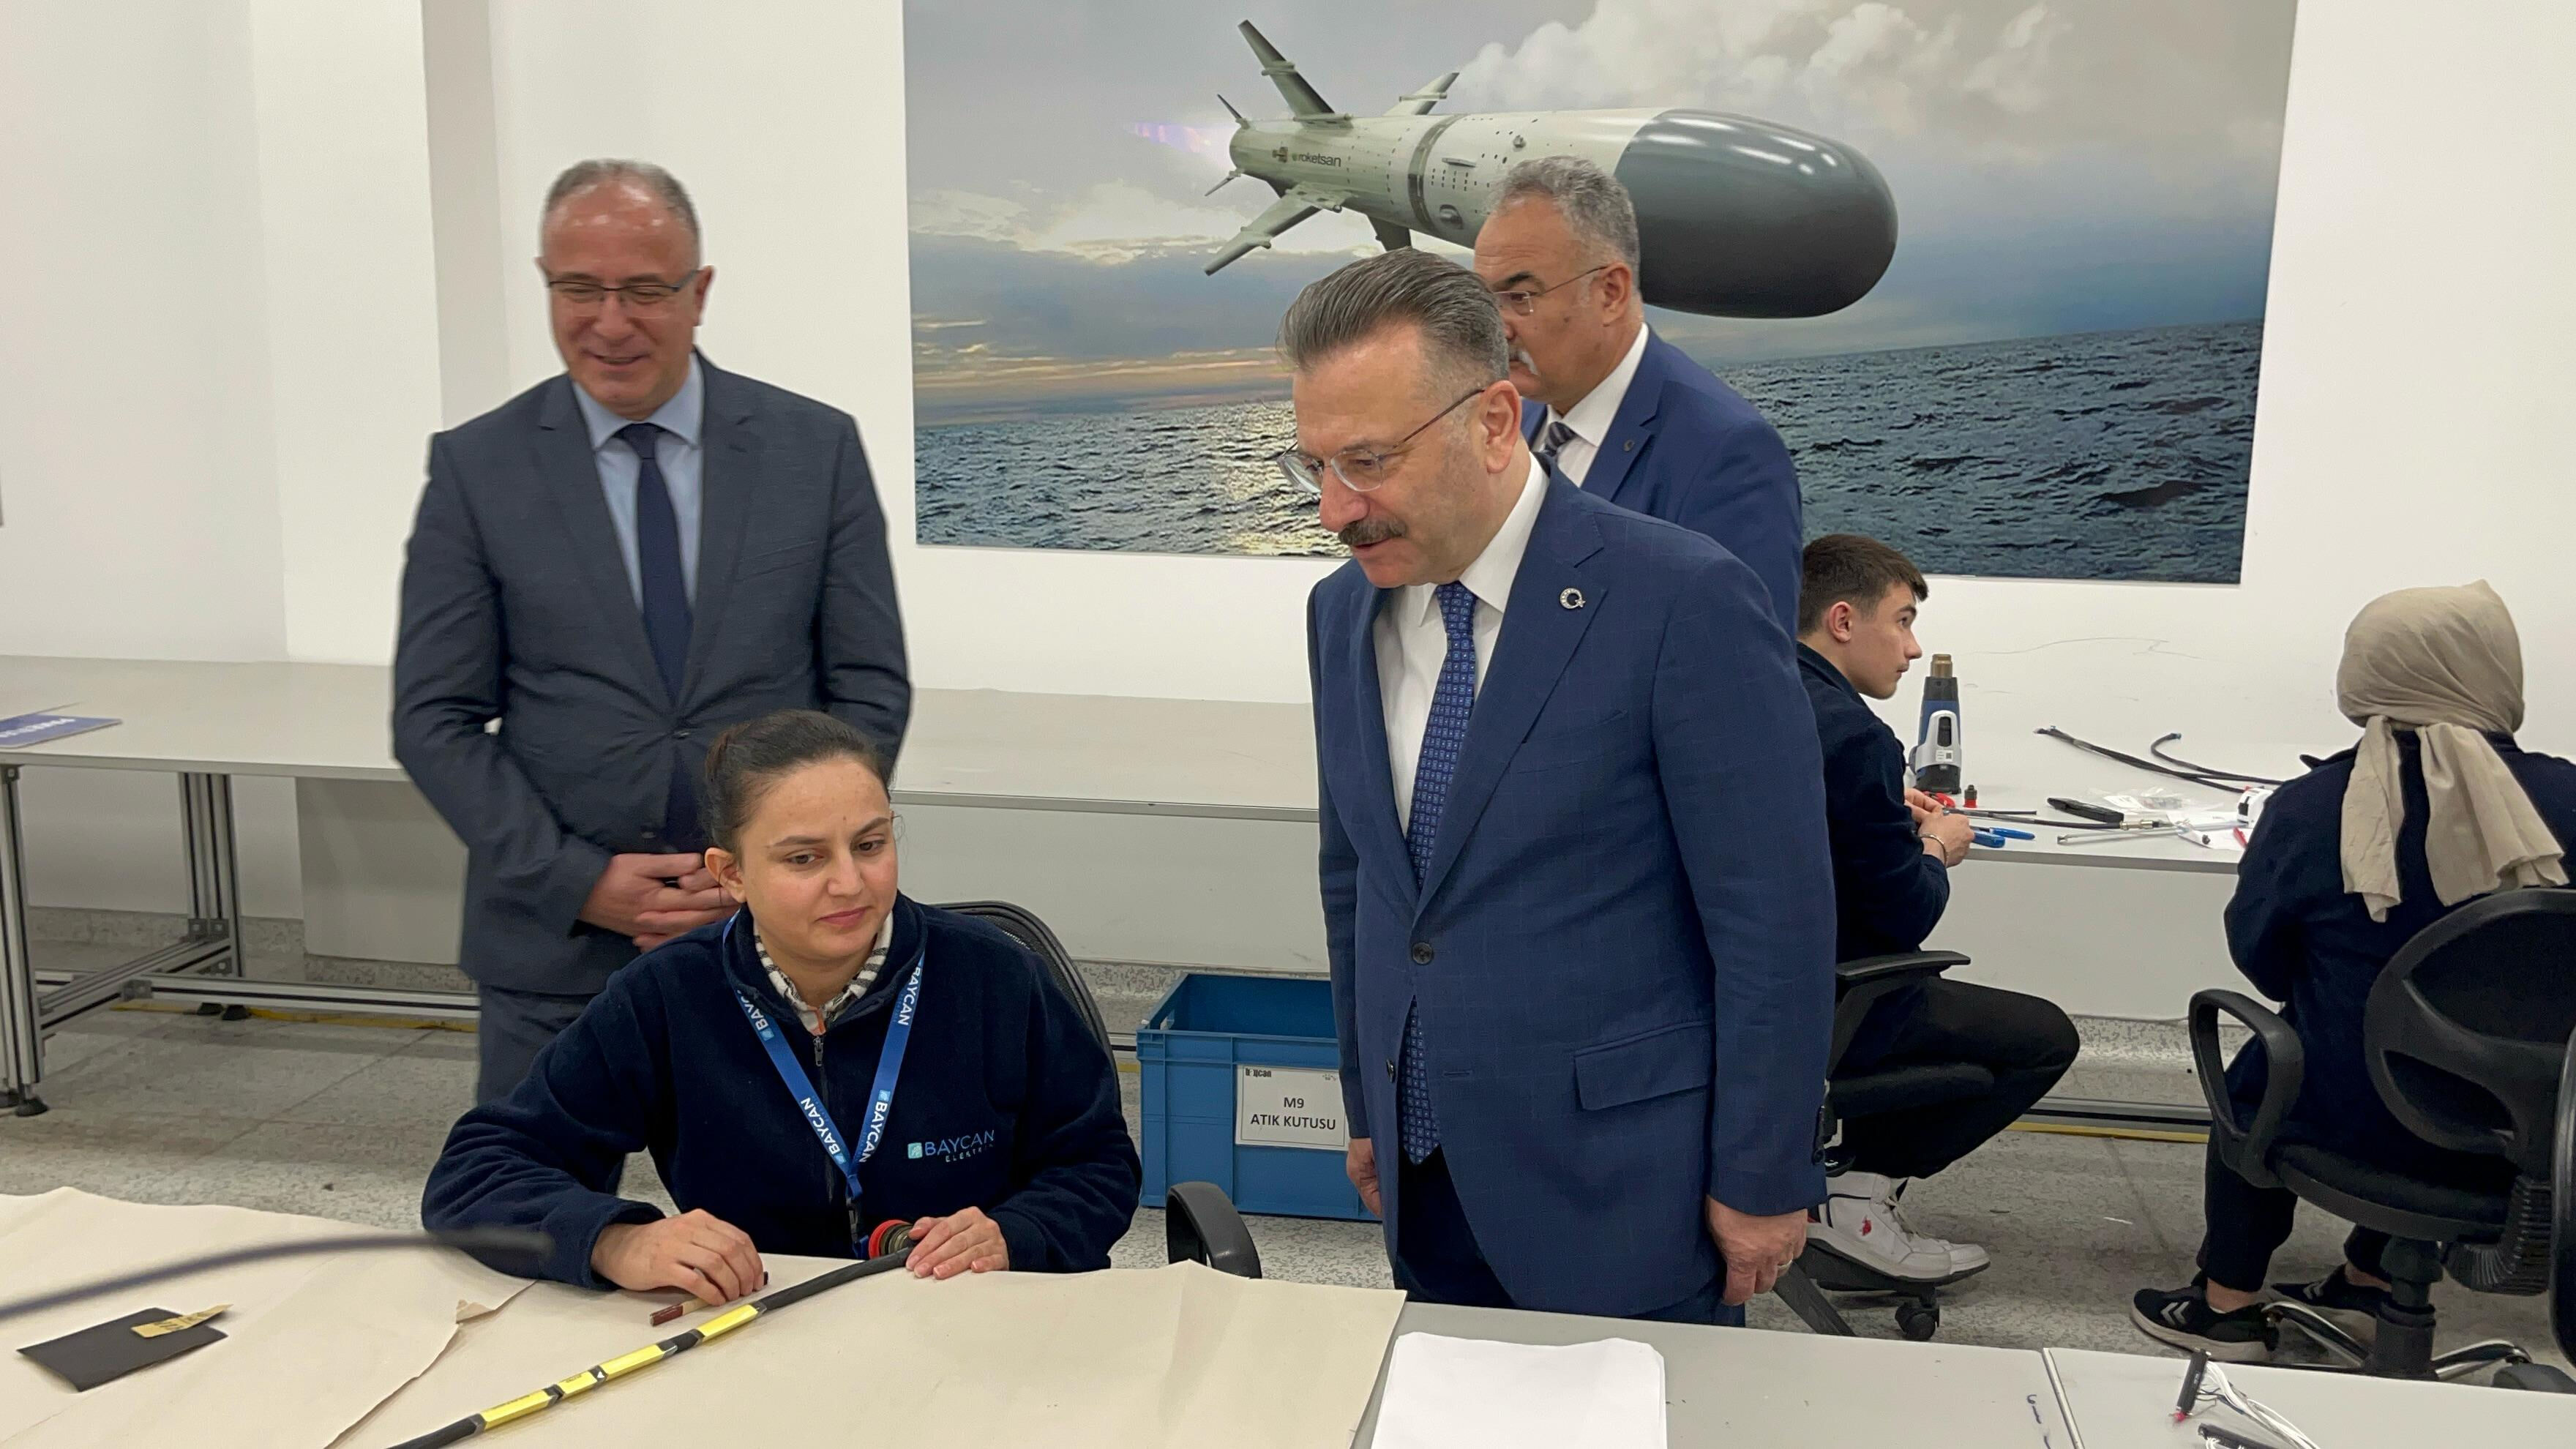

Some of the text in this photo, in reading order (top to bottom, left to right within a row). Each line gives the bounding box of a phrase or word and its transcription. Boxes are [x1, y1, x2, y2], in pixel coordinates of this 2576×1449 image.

[1298, 152, 1341, 168] roketsan
[1284, 1098, 1305, 1109] M9
[801, 1097, 841, 1155] BAYCAN
[858, 1101, 888, 1163] BAYCAN
[1251, 1114, 1336, 1130] ATIK KUTUSU
[924, 1129, 995, 1156] BAYCAN
